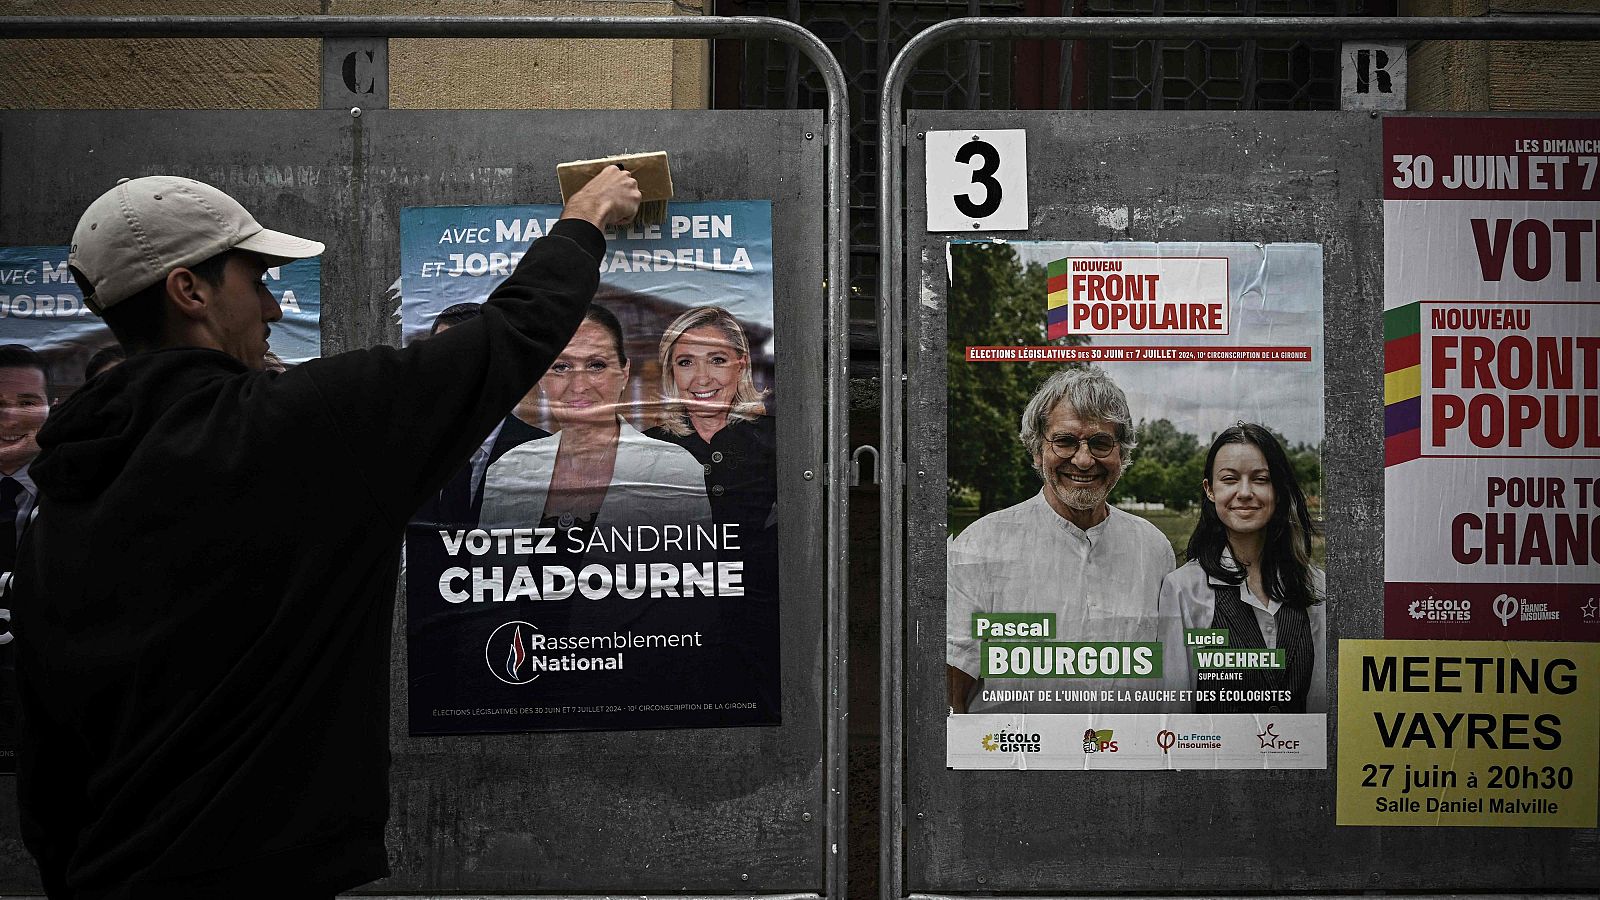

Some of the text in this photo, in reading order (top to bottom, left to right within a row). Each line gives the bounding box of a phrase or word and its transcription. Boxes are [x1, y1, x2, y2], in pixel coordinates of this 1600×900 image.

[342, 50, 374, 94] C
[1357, 50, 1393, 94] R
[1516, 140, 1539, 152] LES
[954, 140, 1002, 218] 3
[1392, 155, 1598, 190] 30 JUIN ET 7
[438, 227, 490, 244] AVEC
[672, 215, 732, 239] PEN
[1470, 218, 1600, 282] VOT
[421, 262, 445, 278] ET
[1072, 261, 1122, 272] NOUVEAU
[1072, 274, 1160, 301] FRONT
[1072, 302, 1222, 330] POPULAIRE
[1432, 308, 1530, 330] NOUVEAU
[970, 348, 1016, 358] ÉLECTIONS
[1018, 348, 1076, 358] LÉGISLATIVES
[1091, 350, 1101, 359] 30
[1104, 350, 1124, 359] JUIN
[1136, 350, 1141, 359] 7
[1142, 350, 1176, 359] JUILLET
[1488, 476, 1566, 508] POUR
[439, 524, 741, 556] VOTEZ SANDRINE
[439, 561, 745, 604] CHADOURNE
[1428, 596, 1470, 610] ÉCOLO
[1521, 604, 1548, 614] FRANCE
[1428, 611, 1470, 620] GISTES
[976, 618, 1049, 637] Pascal
[532, 631, 702, 650] Rassemblement
[1188, 633, 1224, 646] Lucie
[532, 653, 624, 672] National
[988, 646, 1153, 675] BOURGOIS
[1197, 652, 1280, 668] WOEHREL
[1198, 670, 1243, 681] SUPPLÉANTE
[1362, 656, 1578, 695] MEETING
[982, 688, 1292, 702] CANDIDAT DE L'UNION DE LA GAUCHE ET DES ÉCOLOGISTES
[432, 708, 470, 716] ÉLECTIONS
[472, 707, 518, 716] LÉGISLATIVES
[639, 704, 701, 712] CIRCONSCRIPTION
[1000, 730, 1040, 743] ÉCOLO
[1374, 712, 1562, 750] VAYRES
[1000, 744, 1040, 752] GISTES
[1100, 741, 1118, 752] PS
[1278, 740, 1299, 749] PCF
[1362, 764, 1573, 794] 27 juin à 20h30
[1376, 797, 1558, 814] Salle Daniel Malville
